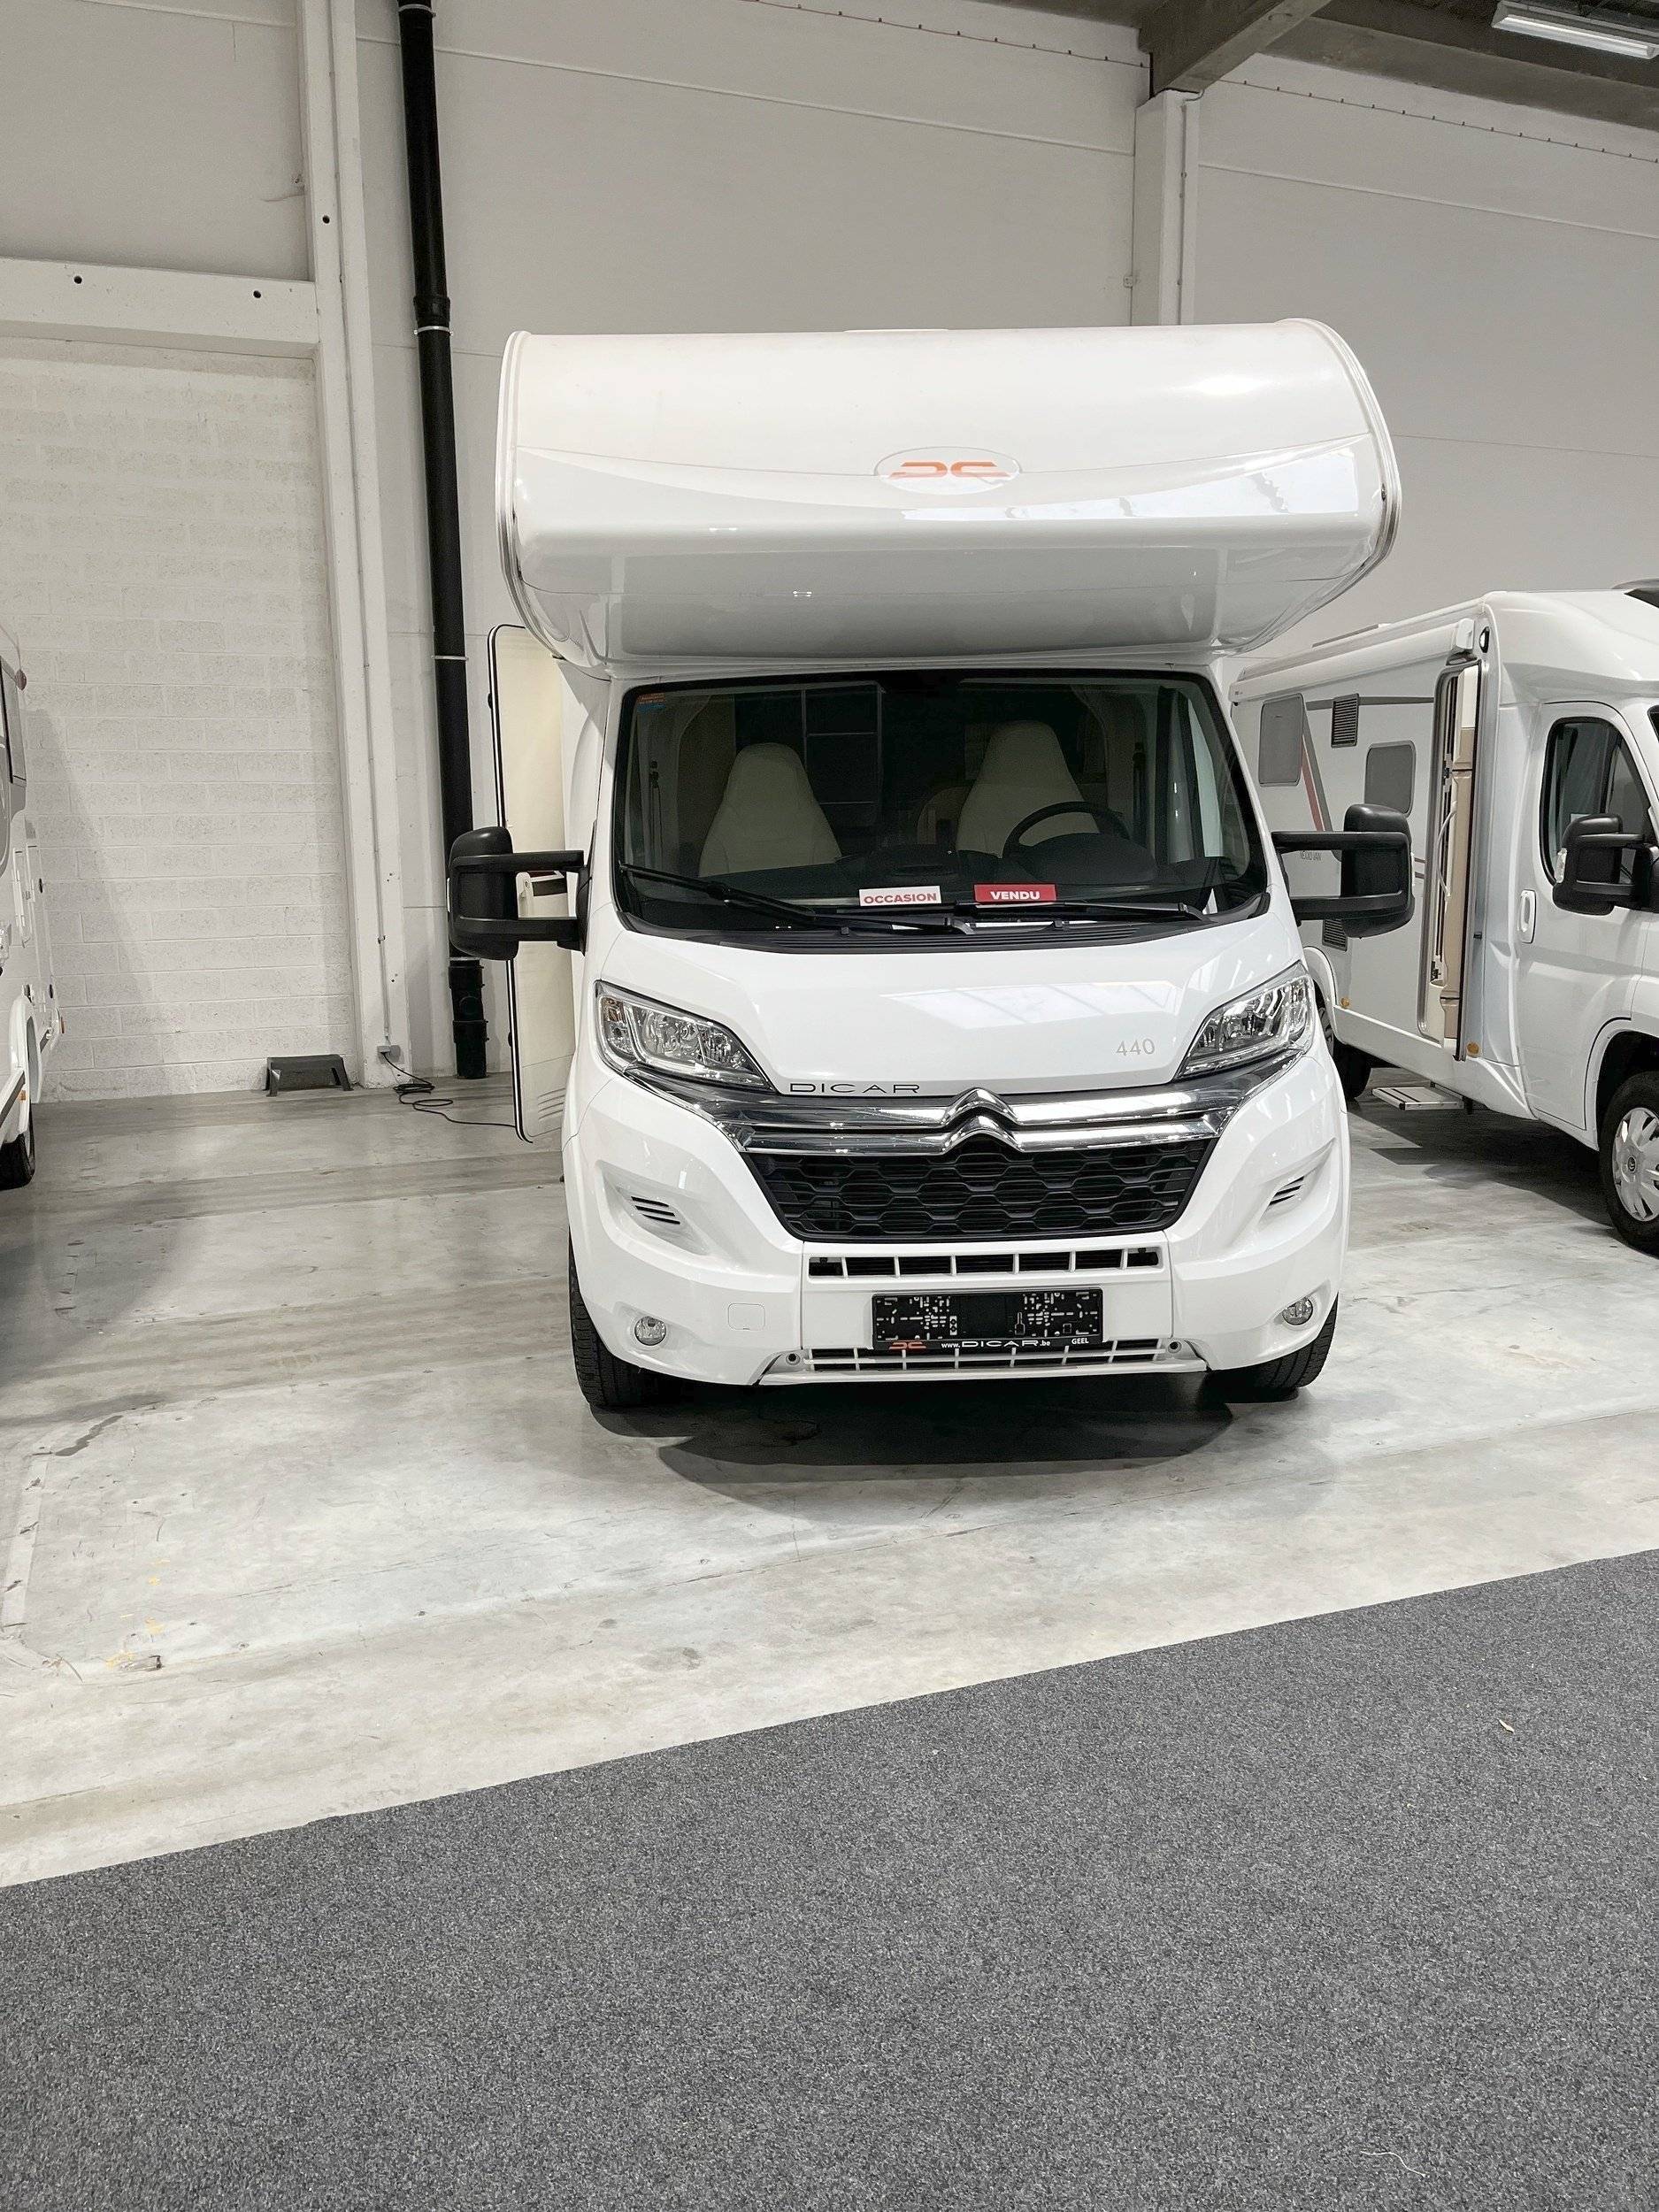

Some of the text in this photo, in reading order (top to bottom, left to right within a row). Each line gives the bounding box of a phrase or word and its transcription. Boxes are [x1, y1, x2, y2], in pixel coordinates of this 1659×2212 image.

[864, 893, 937, 904] OCCASION
[990, 891, 1040, 901] VENDU
[1116, 1038, 1156, 1056] 440
[790, 1083, 920, 1094] DICAR
